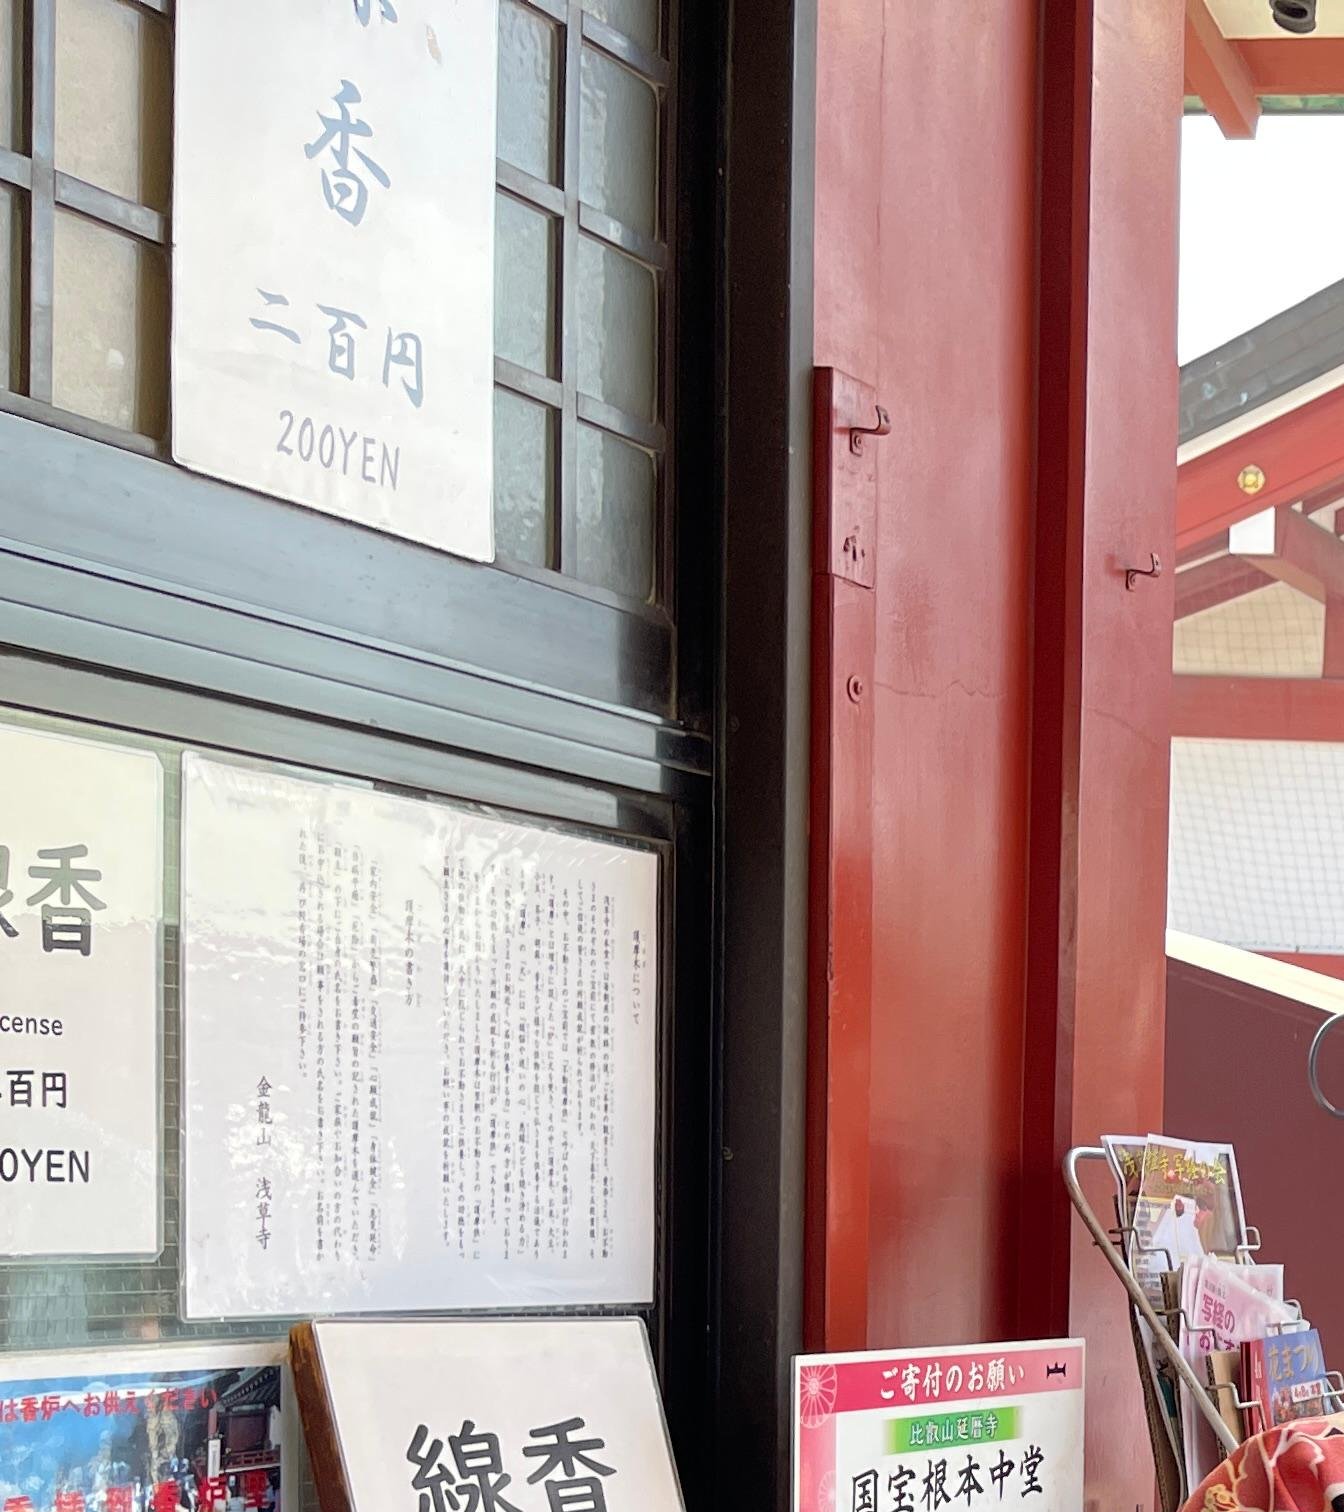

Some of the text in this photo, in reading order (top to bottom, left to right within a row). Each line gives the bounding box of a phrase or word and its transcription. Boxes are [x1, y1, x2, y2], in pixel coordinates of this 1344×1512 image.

[303, 0, 399, 227] 香
[249, 287, 424, 408] 二百円
[276, 409, 401, 491] 200YEN
[255, 1074, 273, 1251] 金龍山 浅草寺
[880, 1357, 1025, 1402] ご寄付のお願い
[909, 1412, 999, 1446] 比叡山延暦寺
